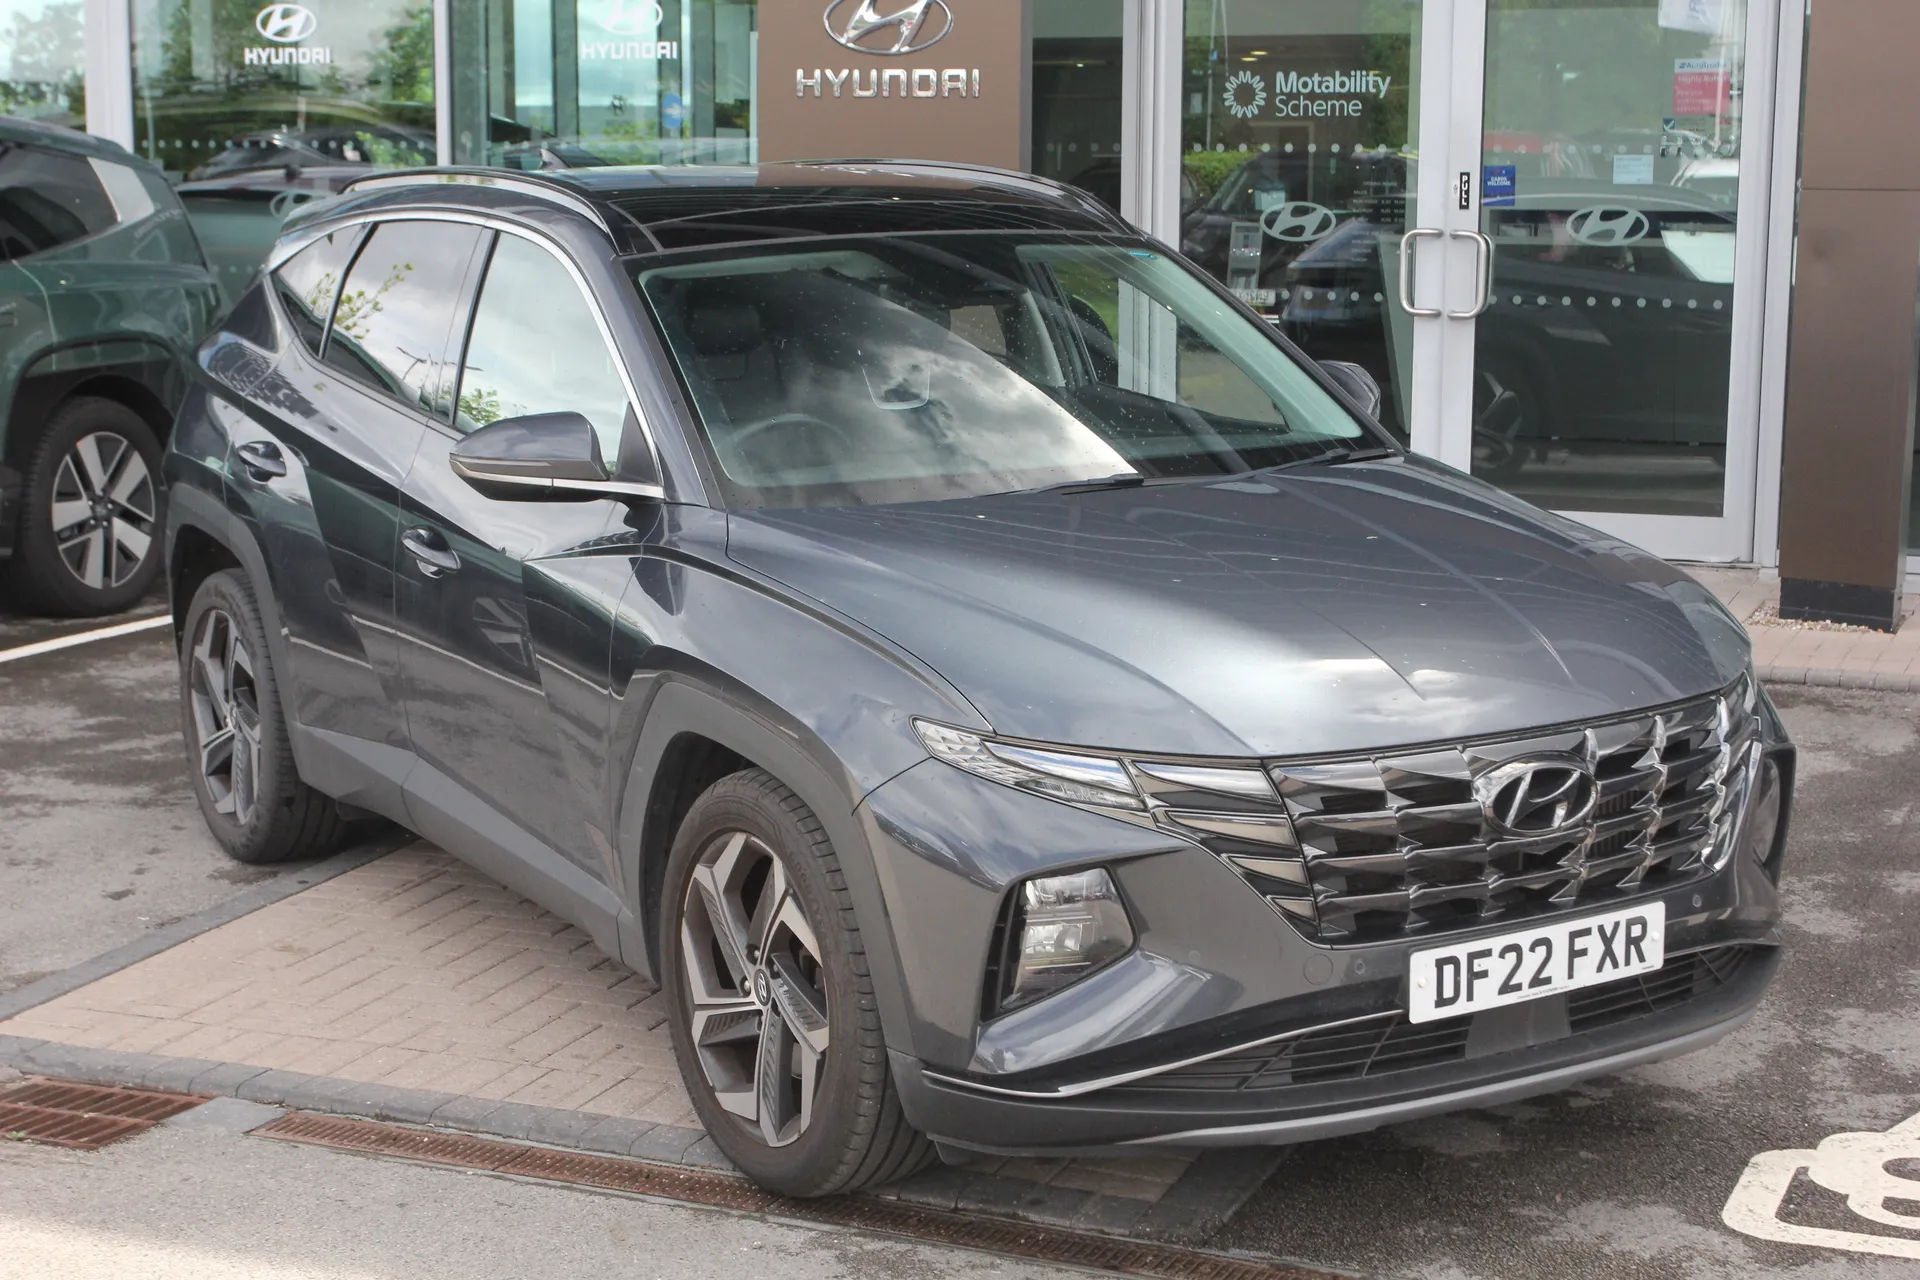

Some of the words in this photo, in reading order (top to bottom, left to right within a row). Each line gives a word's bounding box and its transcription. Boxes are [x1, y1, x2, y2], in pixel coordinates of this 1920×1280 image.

[244, 47, 331, 65] HYUNDAI
[581, 41, 678, 59] HYUNDAI
[796, 68, 980, 98] HYUNDAI
[1275, 70, 1392, 99] Motability
[1275, 96, 1363, 117] Scheme
[1435, 936, 1553, 1009] DF22
[1567, 915, 1648, 980] FXR
